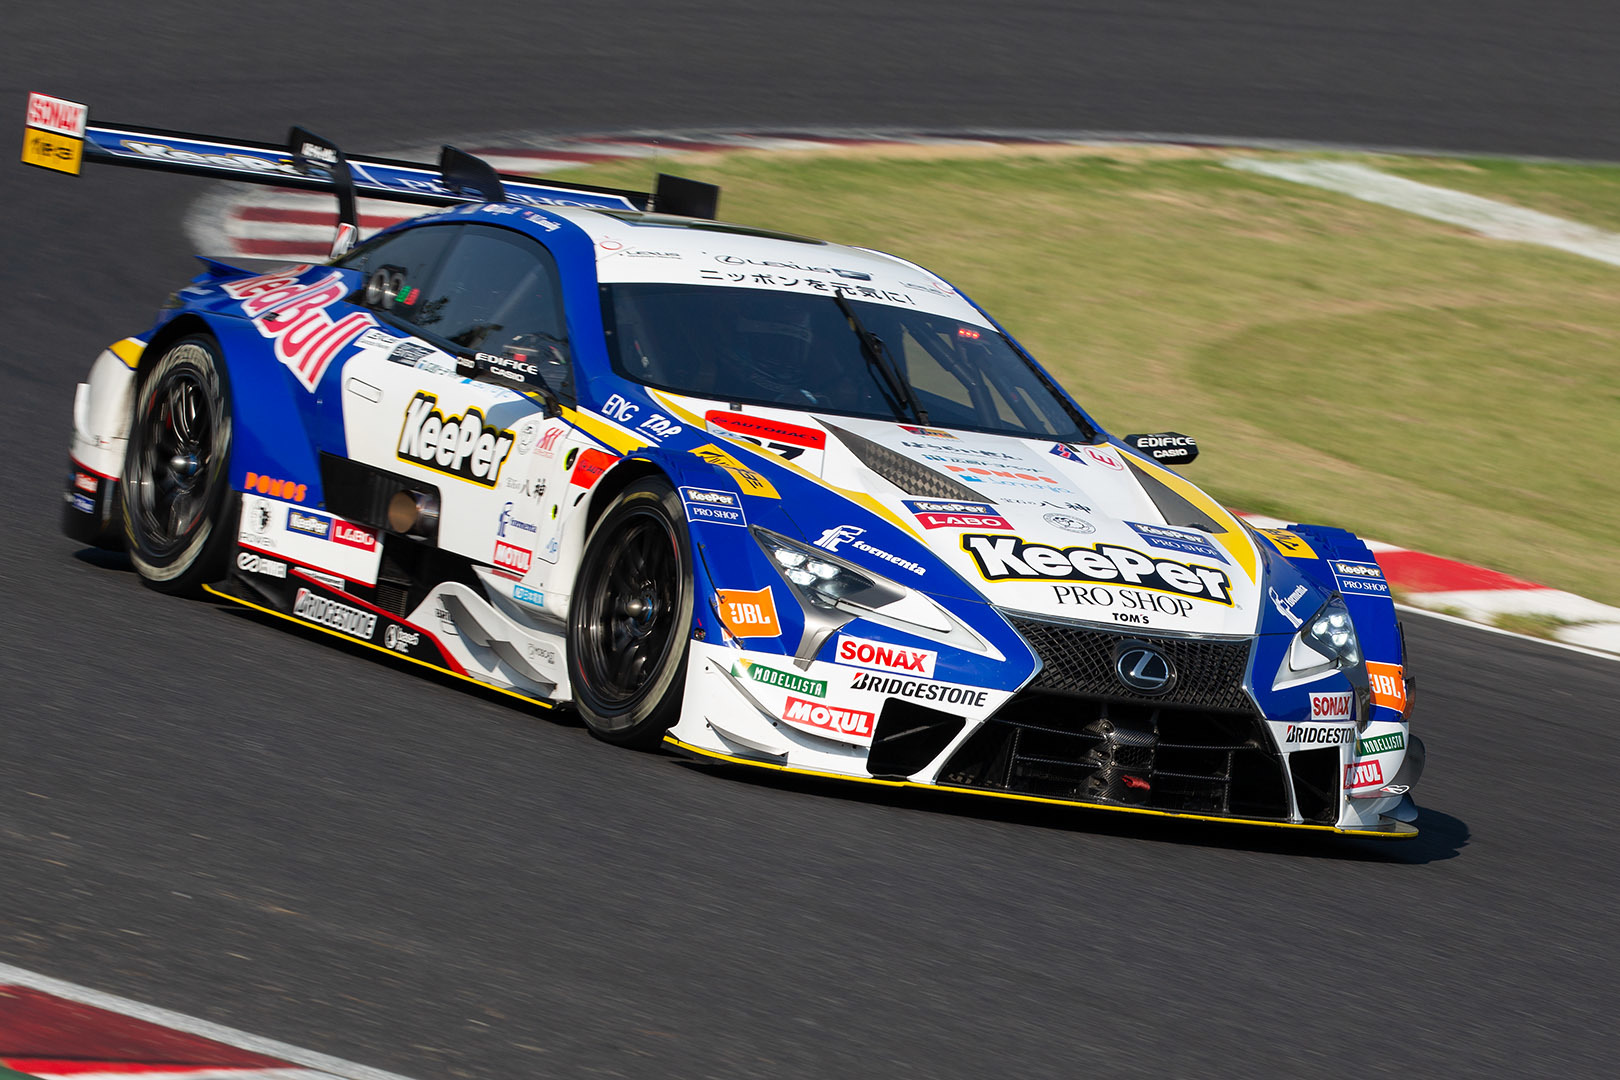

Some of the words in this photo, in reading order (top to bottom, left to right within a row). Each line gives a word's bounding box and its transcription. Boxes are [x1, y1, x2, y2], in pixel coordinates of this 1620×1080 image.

[747, 258, 831, 274] LEXUS
[251, 281, 381, 394] Bull
[475, 352, 539, 375] EDIFICE
[490, 366, 525, 382] CASIO
[397, 392, 515, 488] KeePer
[730, 420, 819, 441] AUTOBACS
[1137, 437, 1196, 448] EDIFICE
[1152, 448, 1188, 458] CASIO
[244, 471, 308, 502] PONOS
[688, 489, 732, 505] KeePer
[693, 507, 714, 517] PRO
[714, 509, 739, 520] SHOP
[914, 502, 987, 514] KeePer
[927, 516, 1002, 527] LABO
[335, 526, 375, 546] LABO
[1135, 524, 1205, 543] KeePer
[495, 543, 530, 570] MOTUL
[1151, 538, 1180, 548] PRO
[1181, 543, 1217, 555] SHOP
[964, 535, 1231, 604] KeePer
[1336, 563, 1381, 577] KeePer
[1343, 580, 1362, 589] PRO
[1363, 582, 1388, 592] SHOP
[1050, 585, 1114, 607] PRO
[1118, 590, 1194, 618] SHOP
[729, 602, 771, 625] JBL
[1112, 612, 1150, 625] TOM'S
[840, 640, 928, 673] SONAX
[753, 666, 823, 697] MODELLISTA
[850, 672, 989, 707] BRIDGESTONE
[1370, 674, 1402, 699] JBL
[1313, 696, 1350, 717] SONAX
[786, 702, 869, 734] MOTUL
[1363, 735, 1403, 753] MODELLISTA
